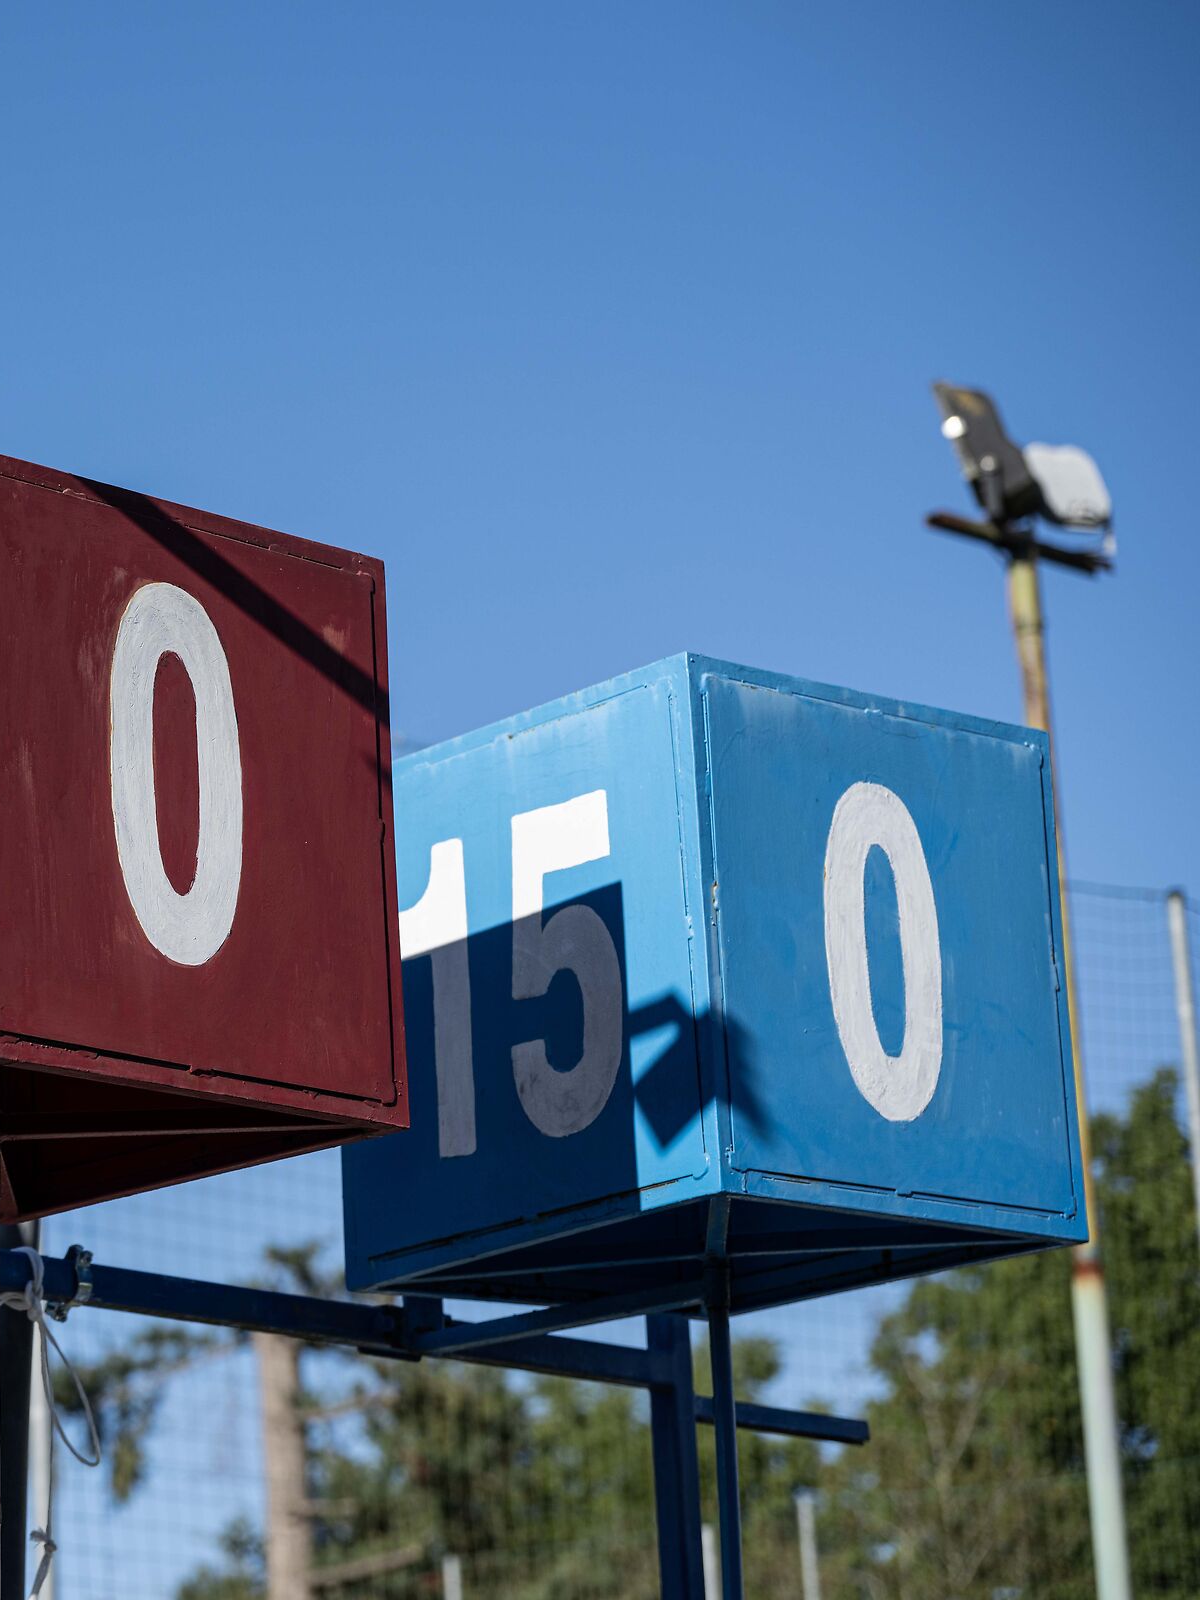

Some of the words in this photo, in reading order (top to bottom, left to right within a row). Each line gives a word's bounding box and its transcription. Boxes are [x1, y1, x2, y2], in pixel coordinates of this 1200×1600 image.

[110, 582, 243, 966] 0
[824, 781, 942, 1122] 0
[399, 789, 623, 1158] 15
